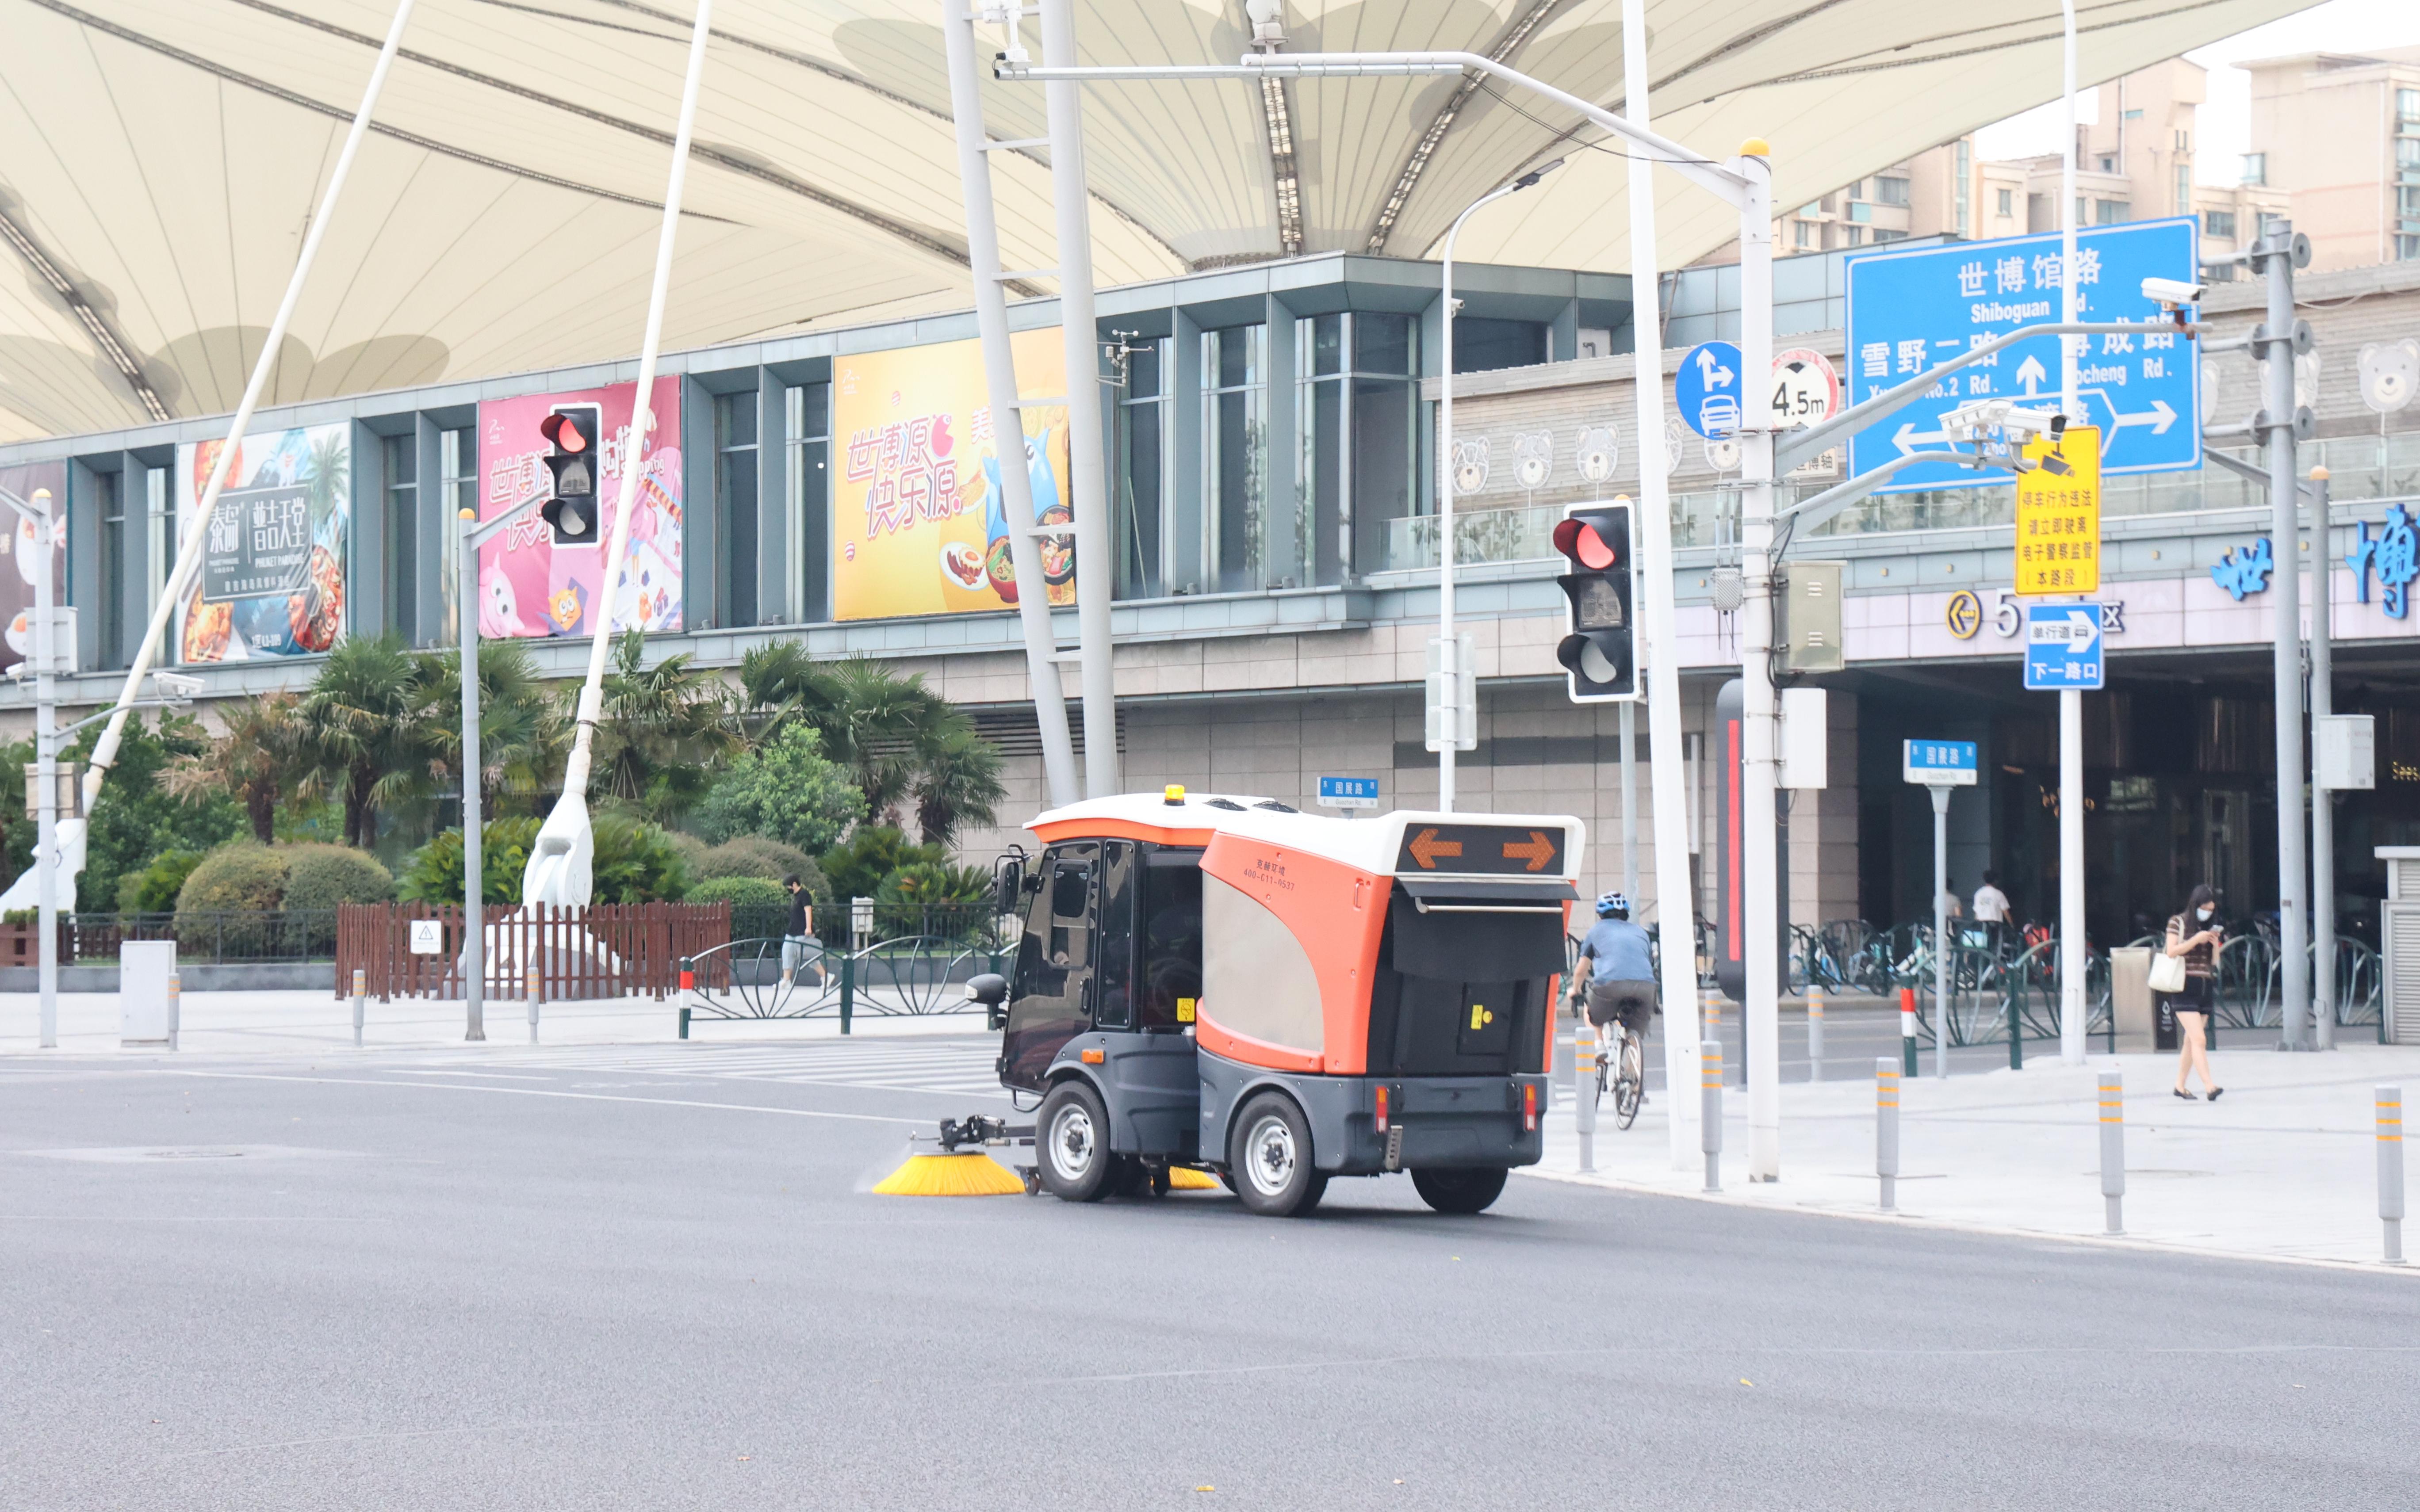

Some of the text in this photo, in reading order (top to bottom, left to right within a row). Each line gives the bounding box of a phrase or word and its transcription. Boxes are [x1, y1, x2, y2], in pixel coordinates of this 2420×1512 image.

[1957, 248, 2102, 298] 世博馆路
[1971, 293, 2094, 324] Shiboguan d.
[1969, 374, 1999, 395] Rd.
[2076, 356, 2173, 386] ocheng Rd.
[1772, 382, 1824, 417] 4.5m
[846, 416, 933, 483] 世博源
[1797, 452, 1833, 472] 博轴
[620, 458, 664, 482] Spping
[865, 459, 960, 540] 快乐源
[2031, 661, 2098, 680] 下一路口
[1336, 781, 1363, 795] 国展路
